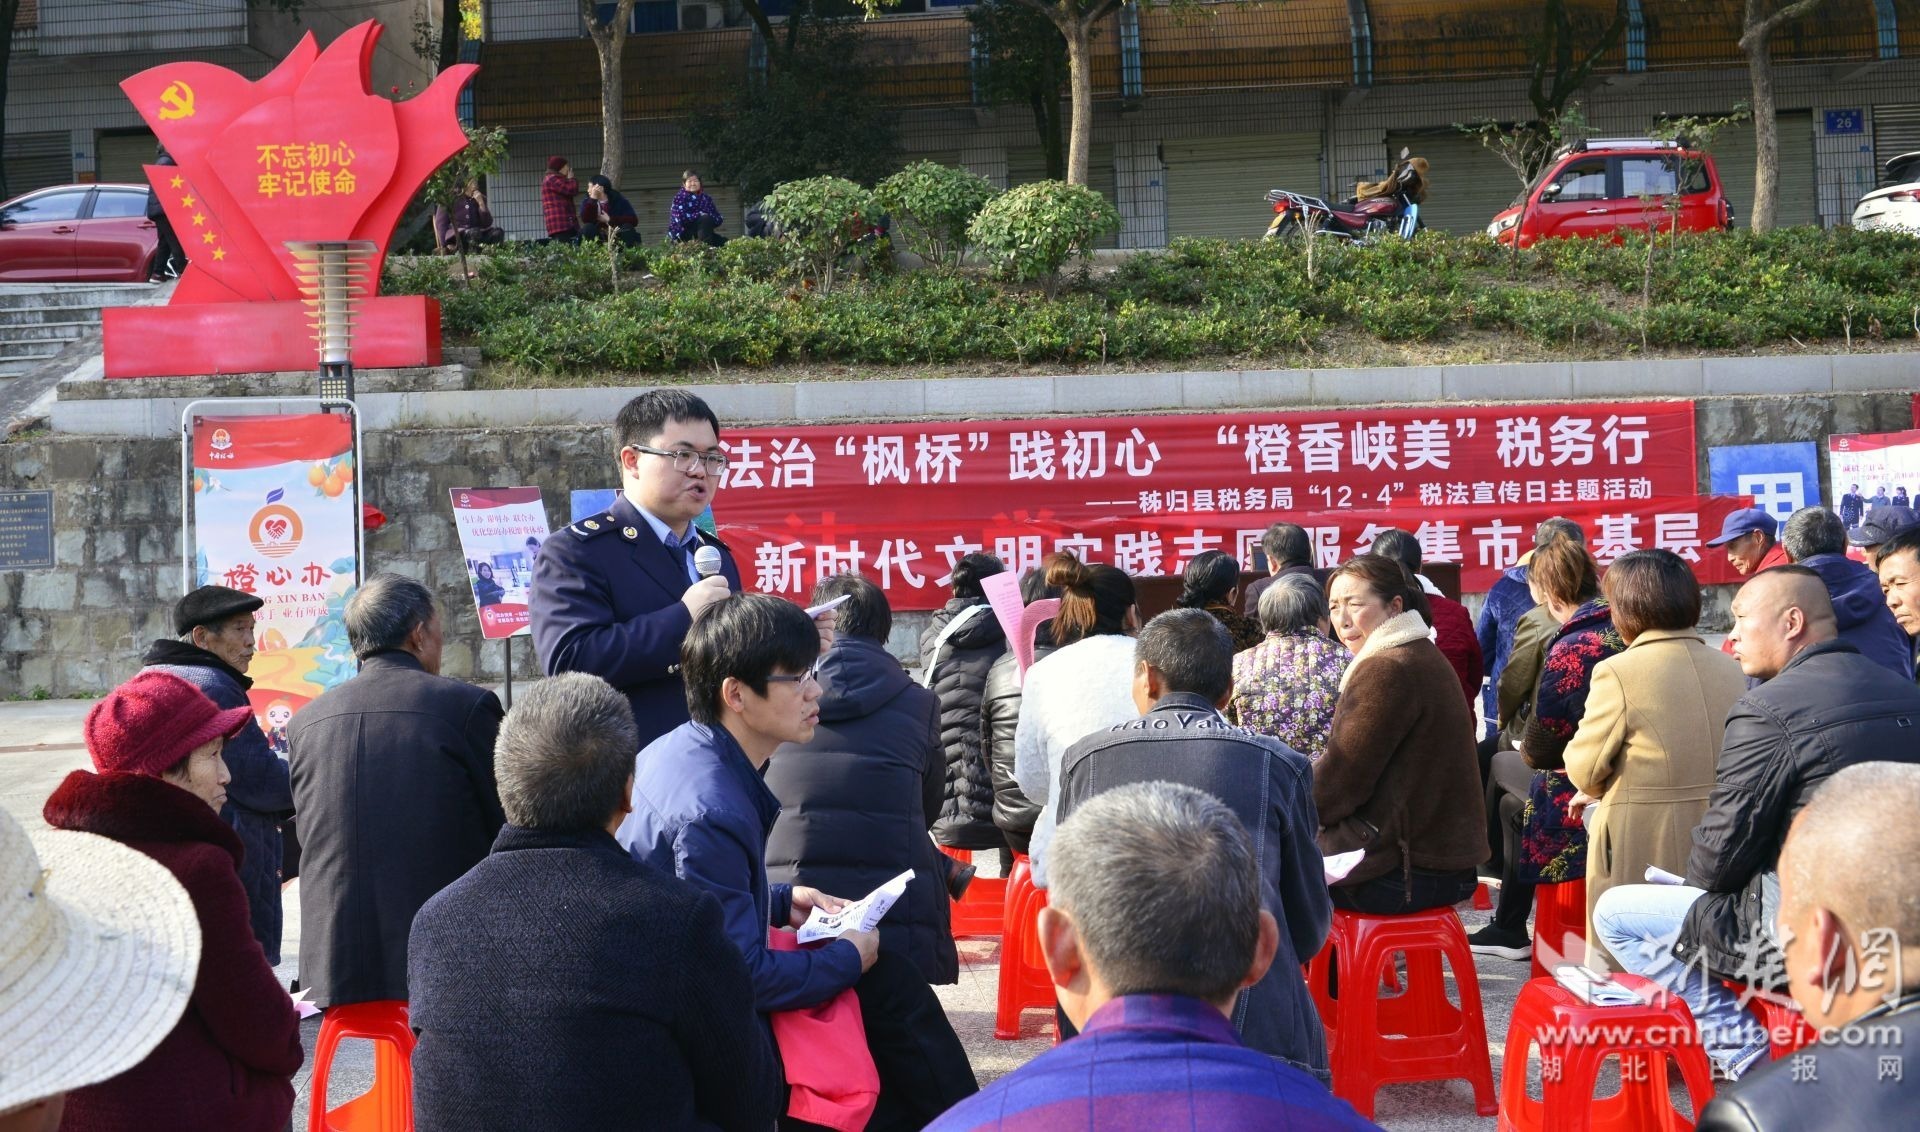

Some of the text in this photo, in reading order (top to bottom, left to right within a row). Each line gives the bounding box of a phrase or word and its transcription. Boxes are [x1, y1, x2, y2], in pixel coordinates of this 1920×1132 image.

[1836, 117, 1852, 129] 26
[256, 140, 356, 170] 不忘初心
[257, 167, 356, 198] 牢记使命
[1217, 414, 1650, 475] “橙香峡美”税务行
[223, 561, 332, 593] 橙心办
[276, 594, 297, 604] XIN
[302, 592, 326, 602] BAN
[282, 604, 329, 618] 业有所成
